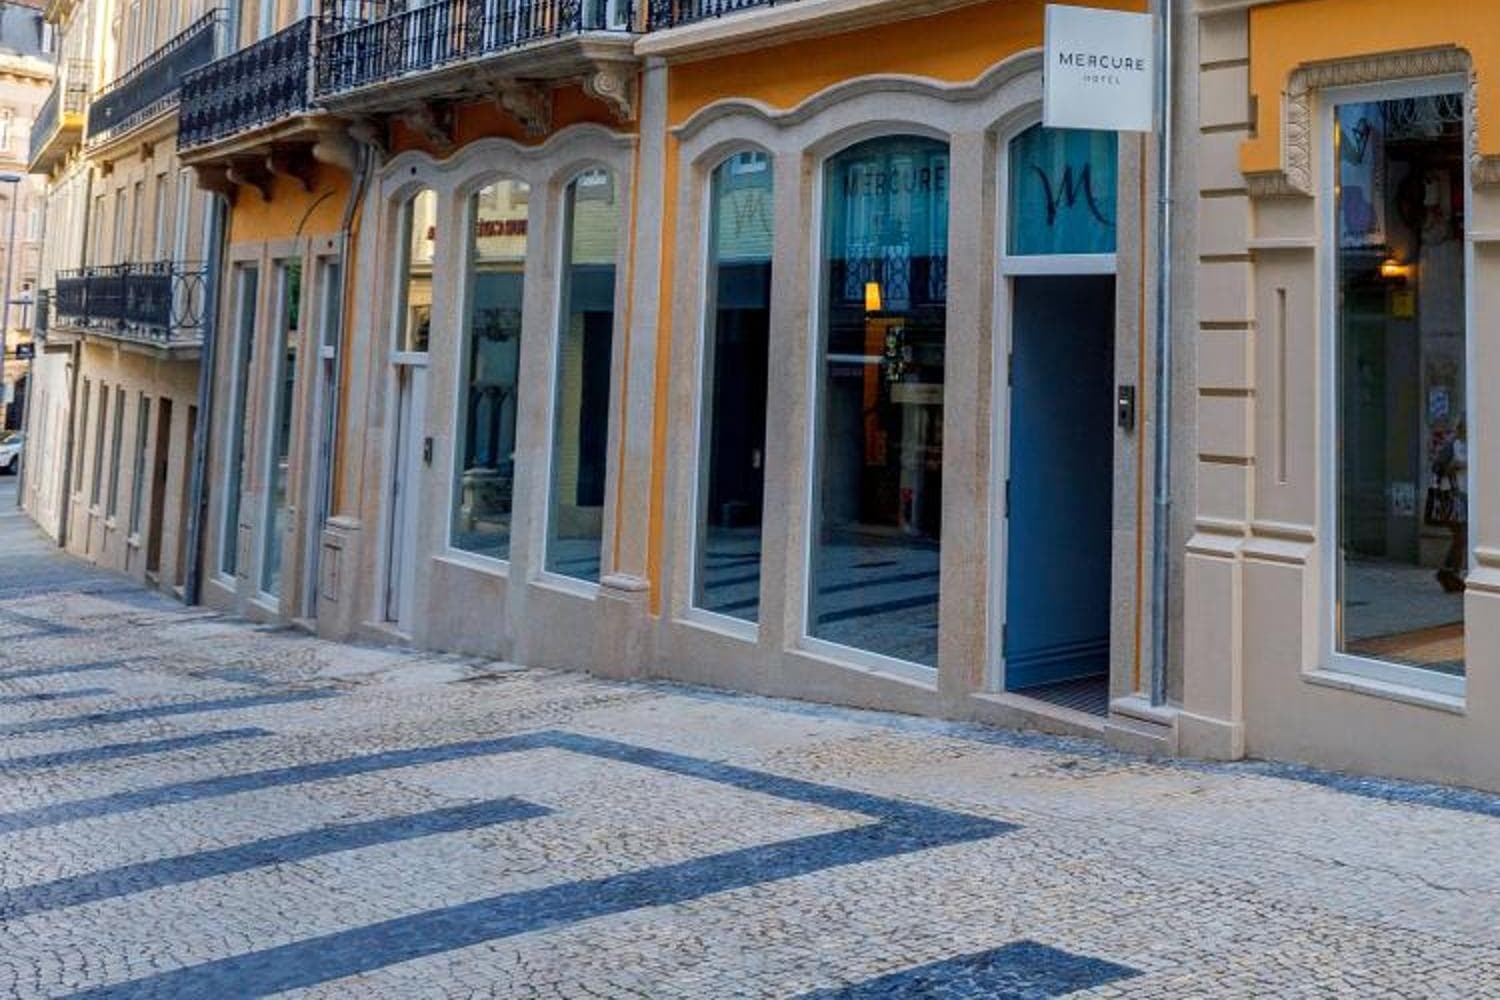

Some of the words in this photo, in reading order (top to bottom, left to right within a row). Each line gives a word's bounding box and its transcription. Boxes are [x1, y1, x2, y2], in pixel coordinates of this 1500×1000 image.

[1058, 51, 1146, 72] MERCURE
[1083, 74, 1122, 86] HOTEL
[842, 165, 946, 200] MERCURE
